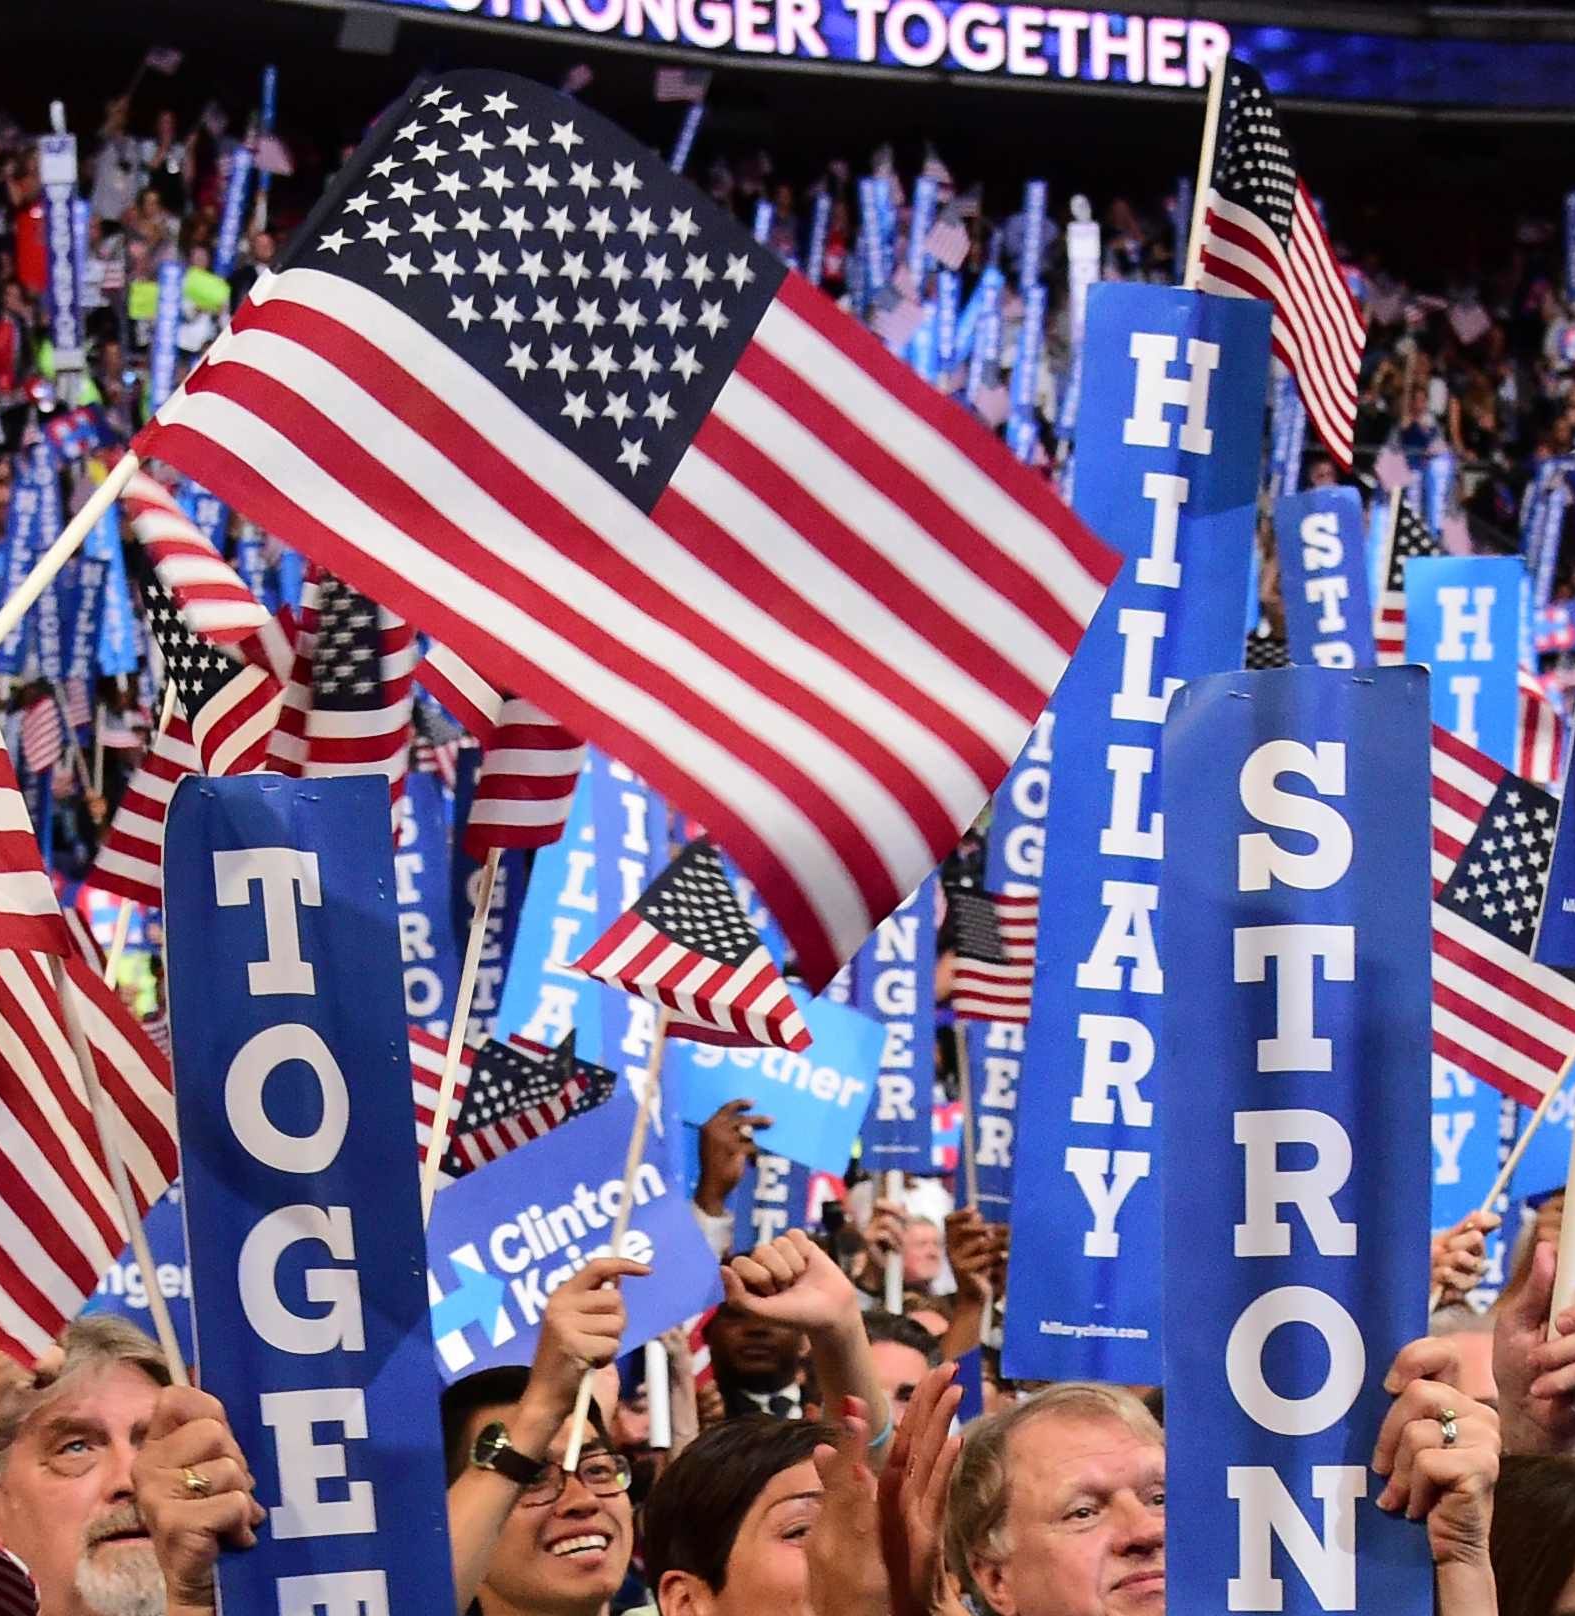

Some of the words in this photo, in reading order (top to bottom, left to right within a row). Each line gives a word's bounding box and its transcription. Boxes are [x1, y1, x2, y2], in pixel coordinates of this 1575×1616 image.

[853, 2, 1229, 88] TOGETHER
[1064, 332, 1221, 1258] HILLARY
[873, 888, 921, 1121] NGER
[489, 1163, 668, 1275] Clinton
